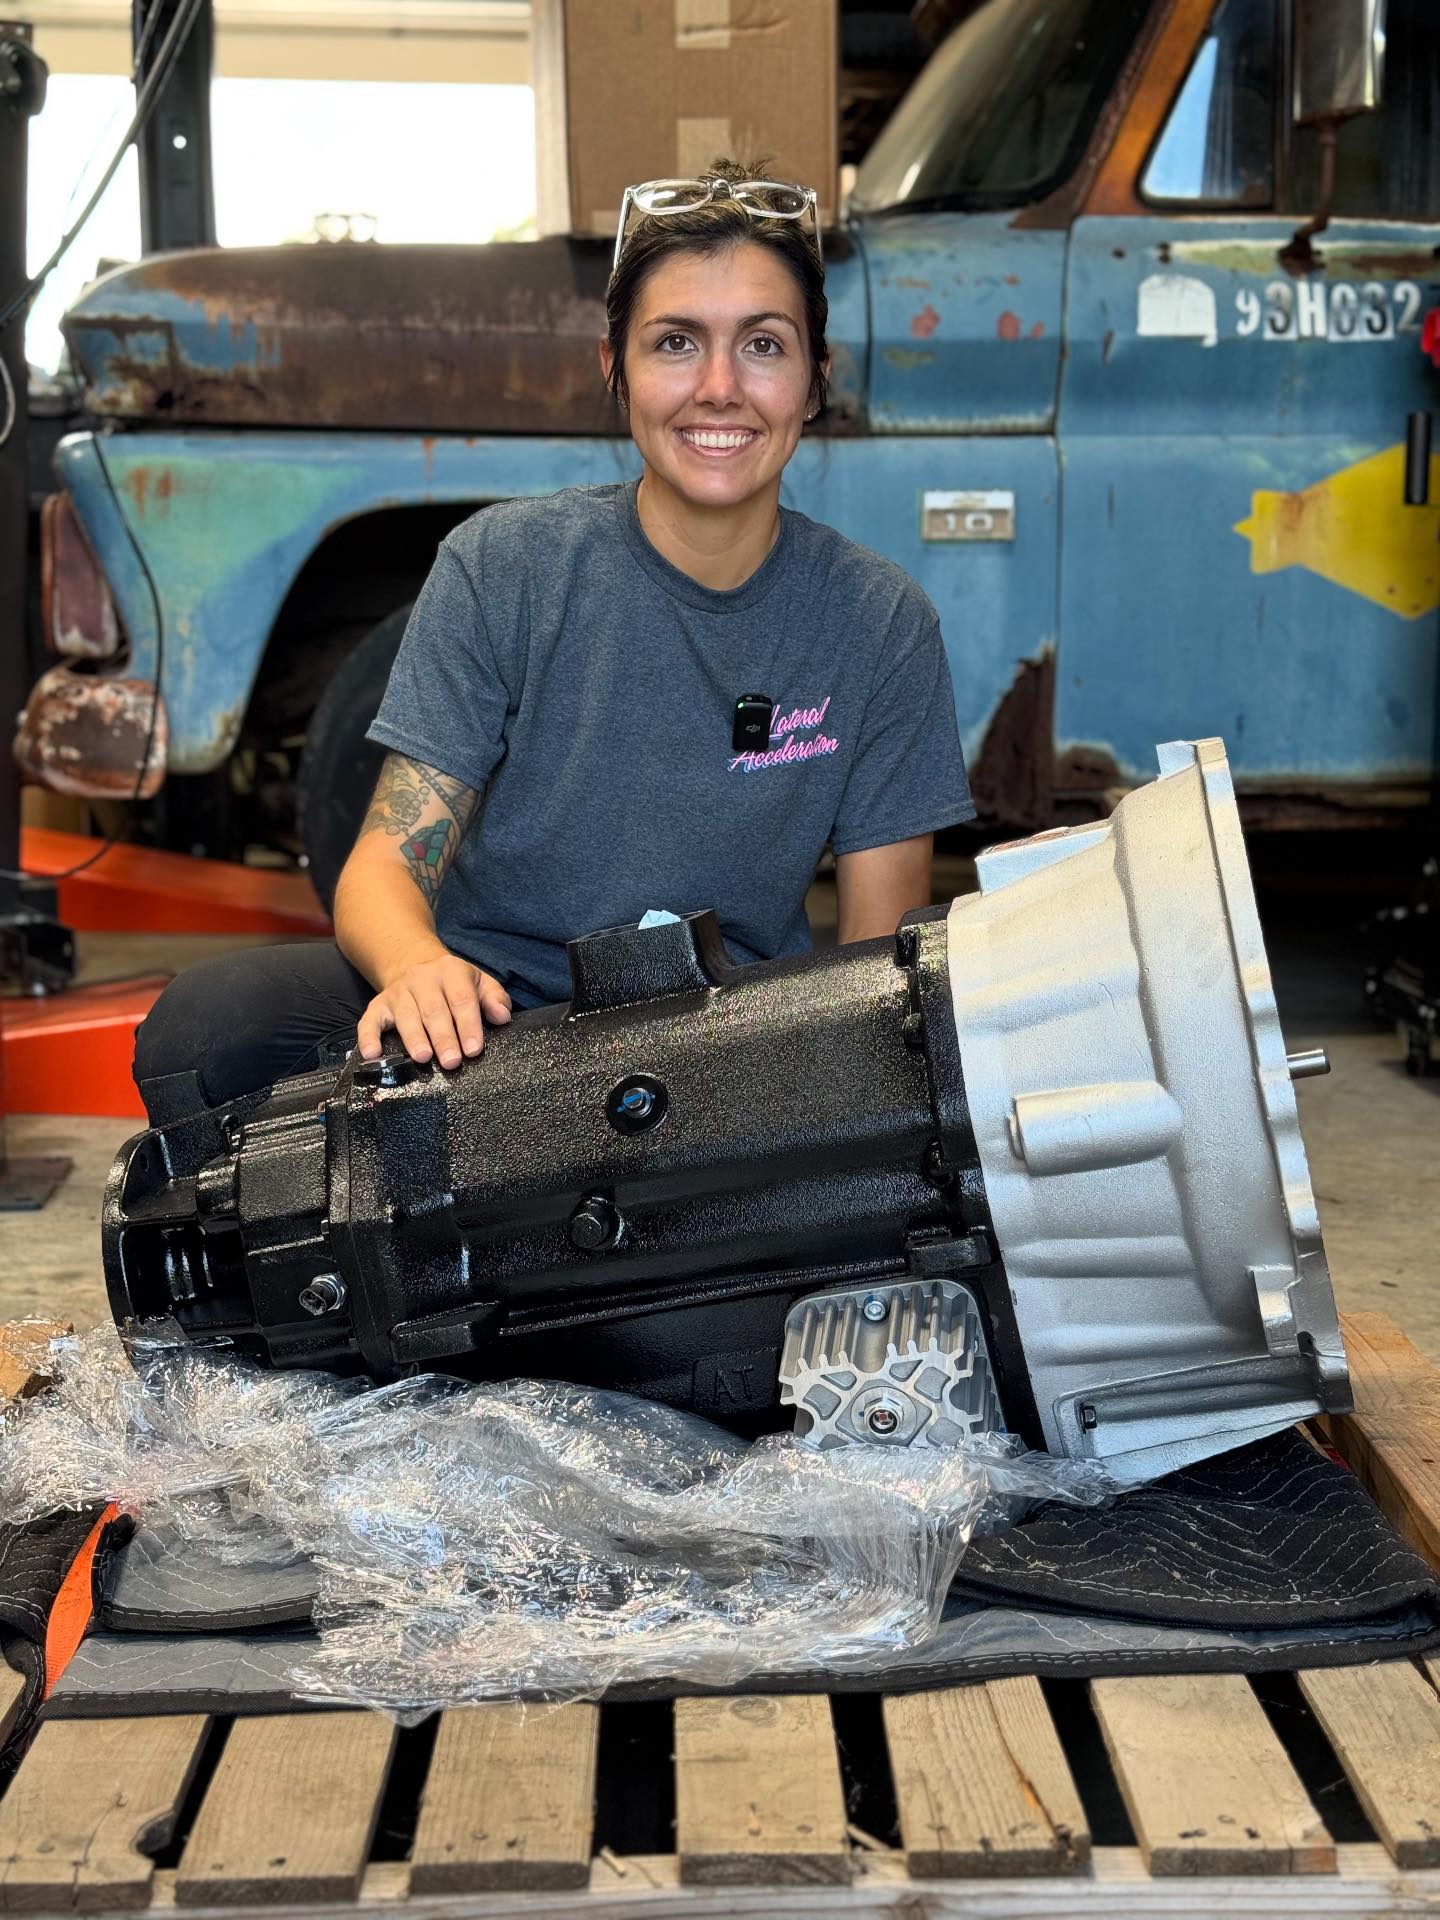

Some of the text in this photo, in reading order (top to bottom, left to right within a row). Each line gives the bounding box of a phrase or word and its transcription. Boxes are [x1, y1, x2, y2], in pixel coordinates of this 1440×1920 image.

[945, 511, 993, 533] 10
[768, 696, 831, 740] Lateral
[727, 733, 839, 773] Acceleration
